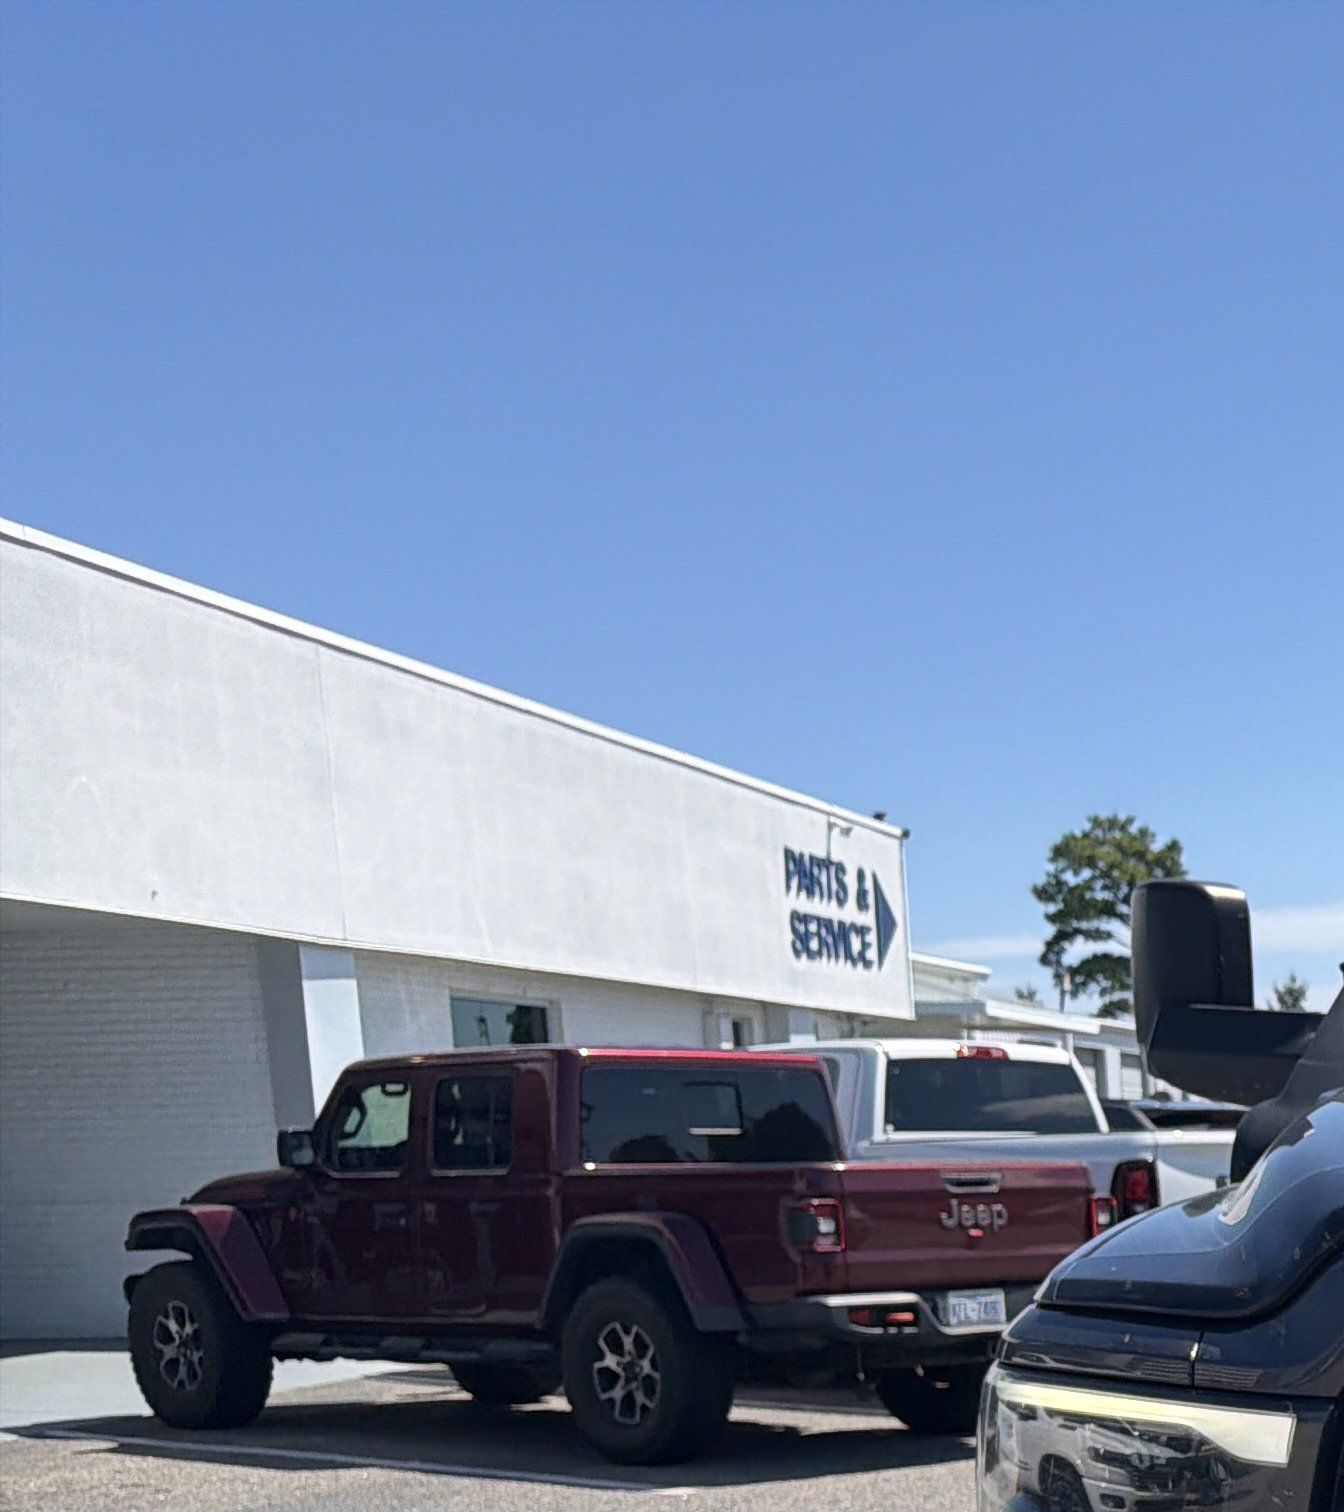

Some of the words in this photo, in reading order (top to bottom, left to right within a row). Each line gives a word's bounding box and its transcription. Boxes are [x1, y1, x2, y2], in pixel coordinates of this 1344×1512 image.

[784, 846, 849, 908] PARTS
[856, 865, 870, 913] &
[790, 909, 874, 970] SERVICE
[940, 1198, 1009, 1232] Jeep
